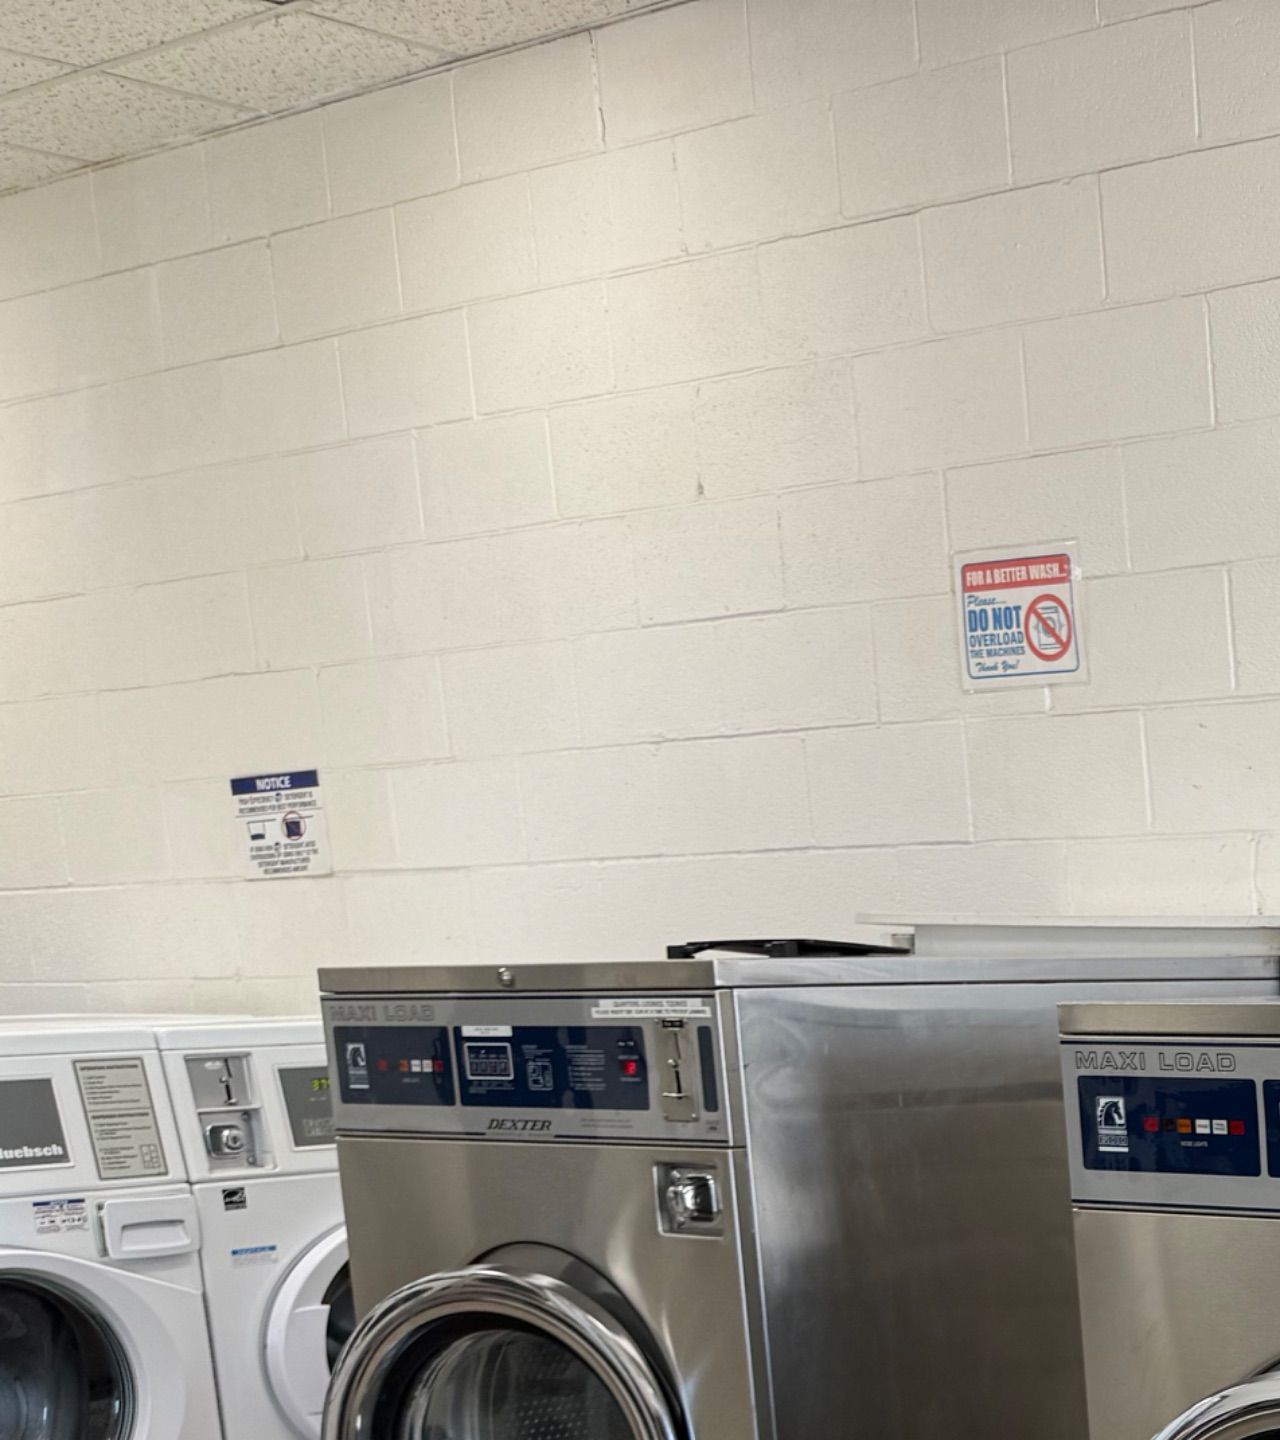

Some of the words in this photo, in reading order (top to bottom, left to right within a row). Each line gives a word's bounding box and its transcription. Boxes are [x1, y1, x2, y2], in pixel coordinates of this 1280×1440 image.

[966, 571, 984, 587] FOR
[986, 569, 993, 585] A
[994, 566, 1026, 584] BETTER
[968, 608, 989, 633] DO
[992, 605, 1022, 631] NOT
[969, 631, 1024, 648] OVERLOAD
[970, 649, 984, 659] THE
[986, 646, 1026, 657] MACHINES
[255, 776, 291, 791] NOTICE
[1075, 1051, 1146, 1070] MAXI
[1158, 1052, 1236, 1073] LOAD
[487, 1118, 552, 1131] DEXTER
